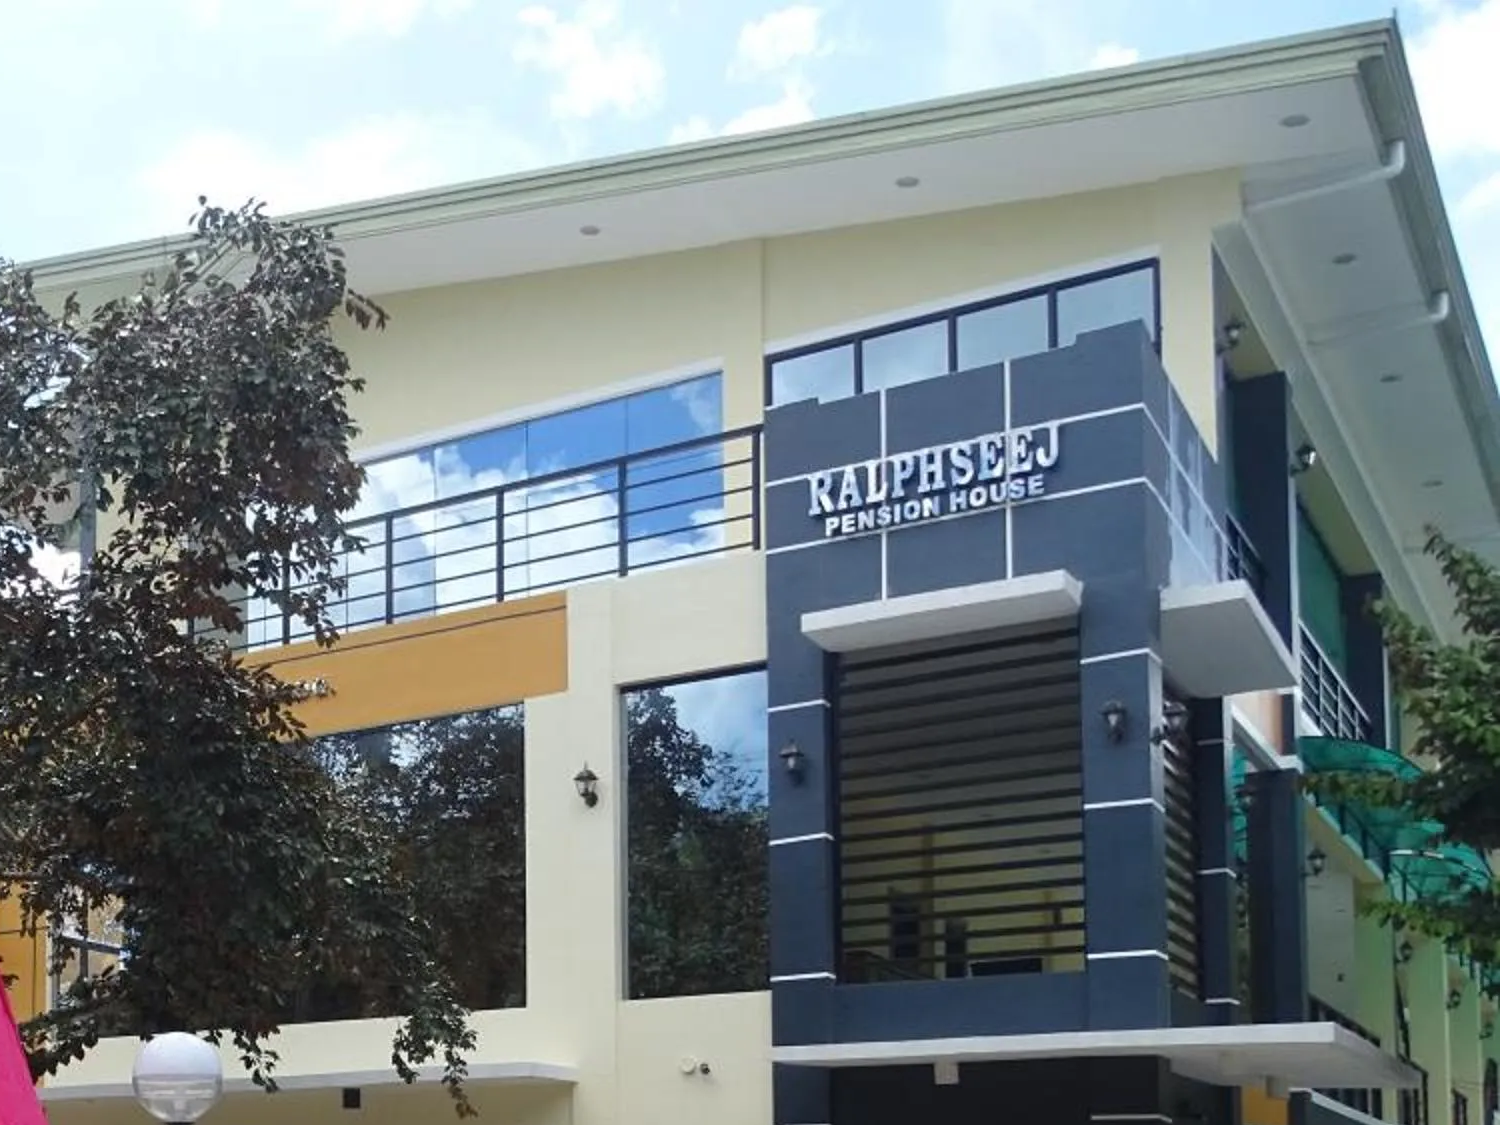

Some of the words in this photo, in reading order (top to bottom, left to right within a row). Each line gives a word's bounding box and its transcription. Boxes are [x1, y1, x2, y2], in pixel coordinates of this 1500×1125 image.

[808, 421, 1059, 516] RALPHSEEJ
[824, 499, 940, 537] PENSION
[951, 474, 1045, 513] HOUSE
